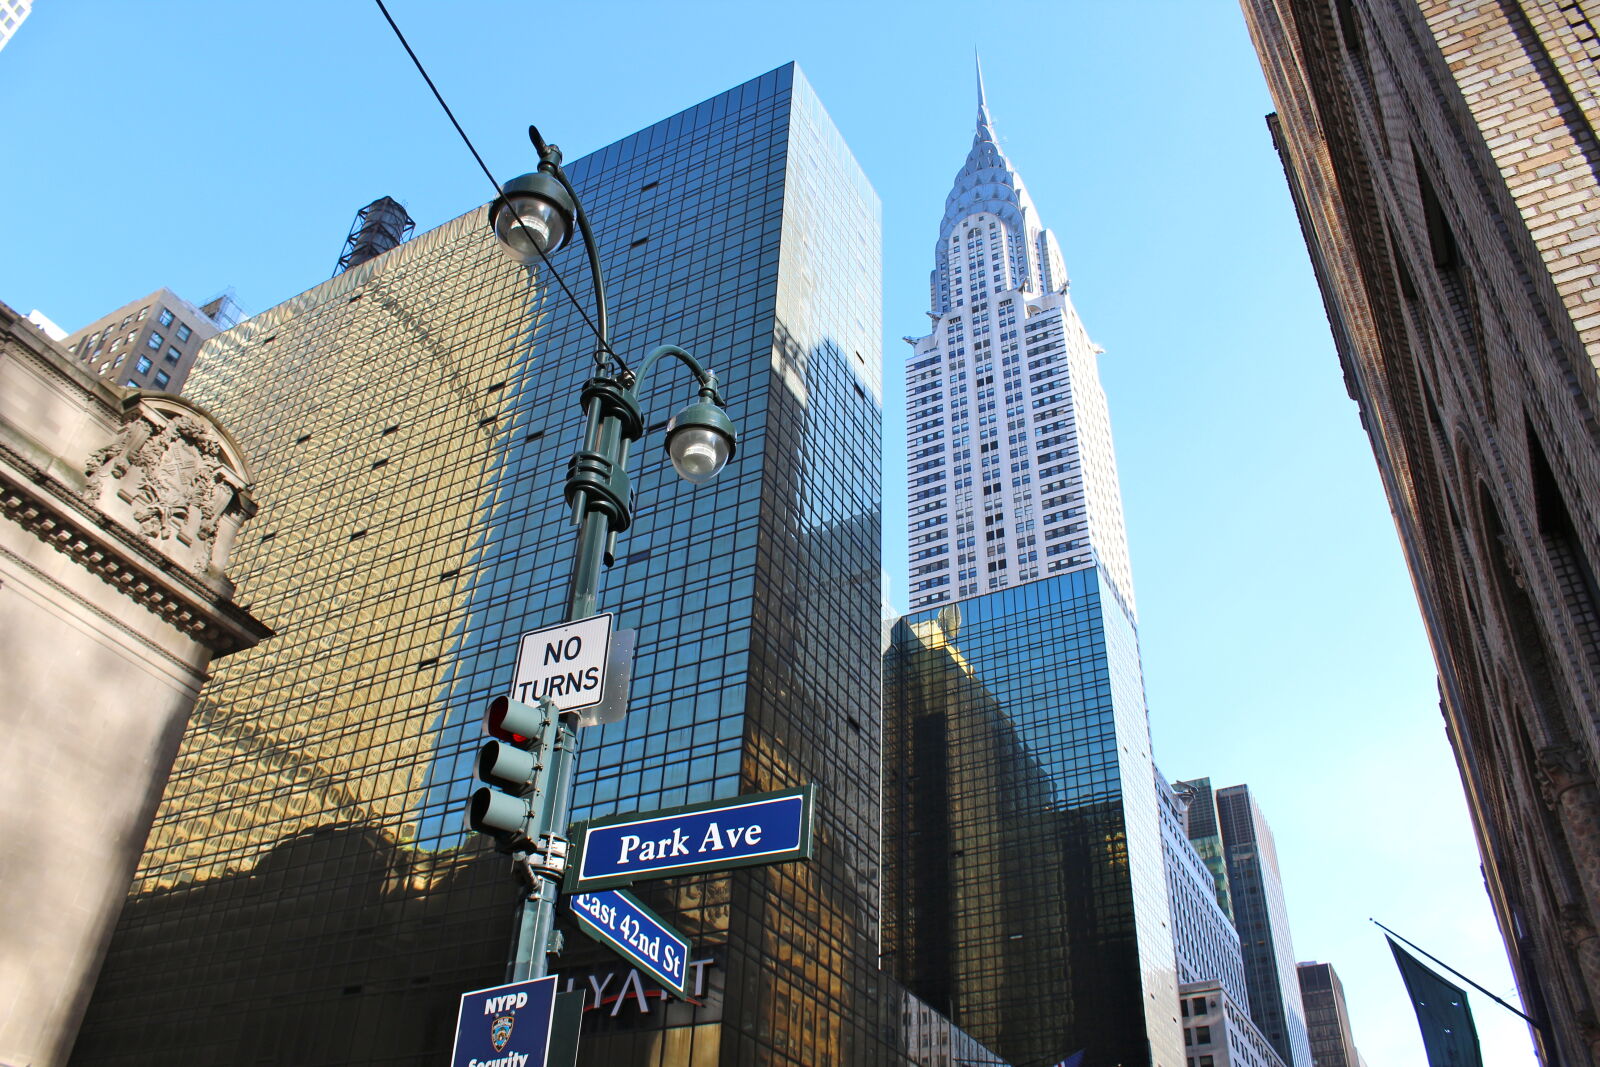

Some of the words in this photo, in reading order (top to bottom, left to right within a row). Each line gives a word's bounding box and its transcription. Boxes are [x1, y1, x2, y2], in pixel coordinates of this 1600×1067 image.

[544, 636, 582, 666] NO
[519, 667, 599, 703] TURNS
[617, 828, 689, 864] Park
[698, 822, 762, 853] Ave
[577, 894, 617, 930] East
[620, 914, 660, 963] 42nd
[663, 944, 681, 978] St
[484, 992, 528, 1015] NYPD
[566, 958, 714, 1017] YAT
